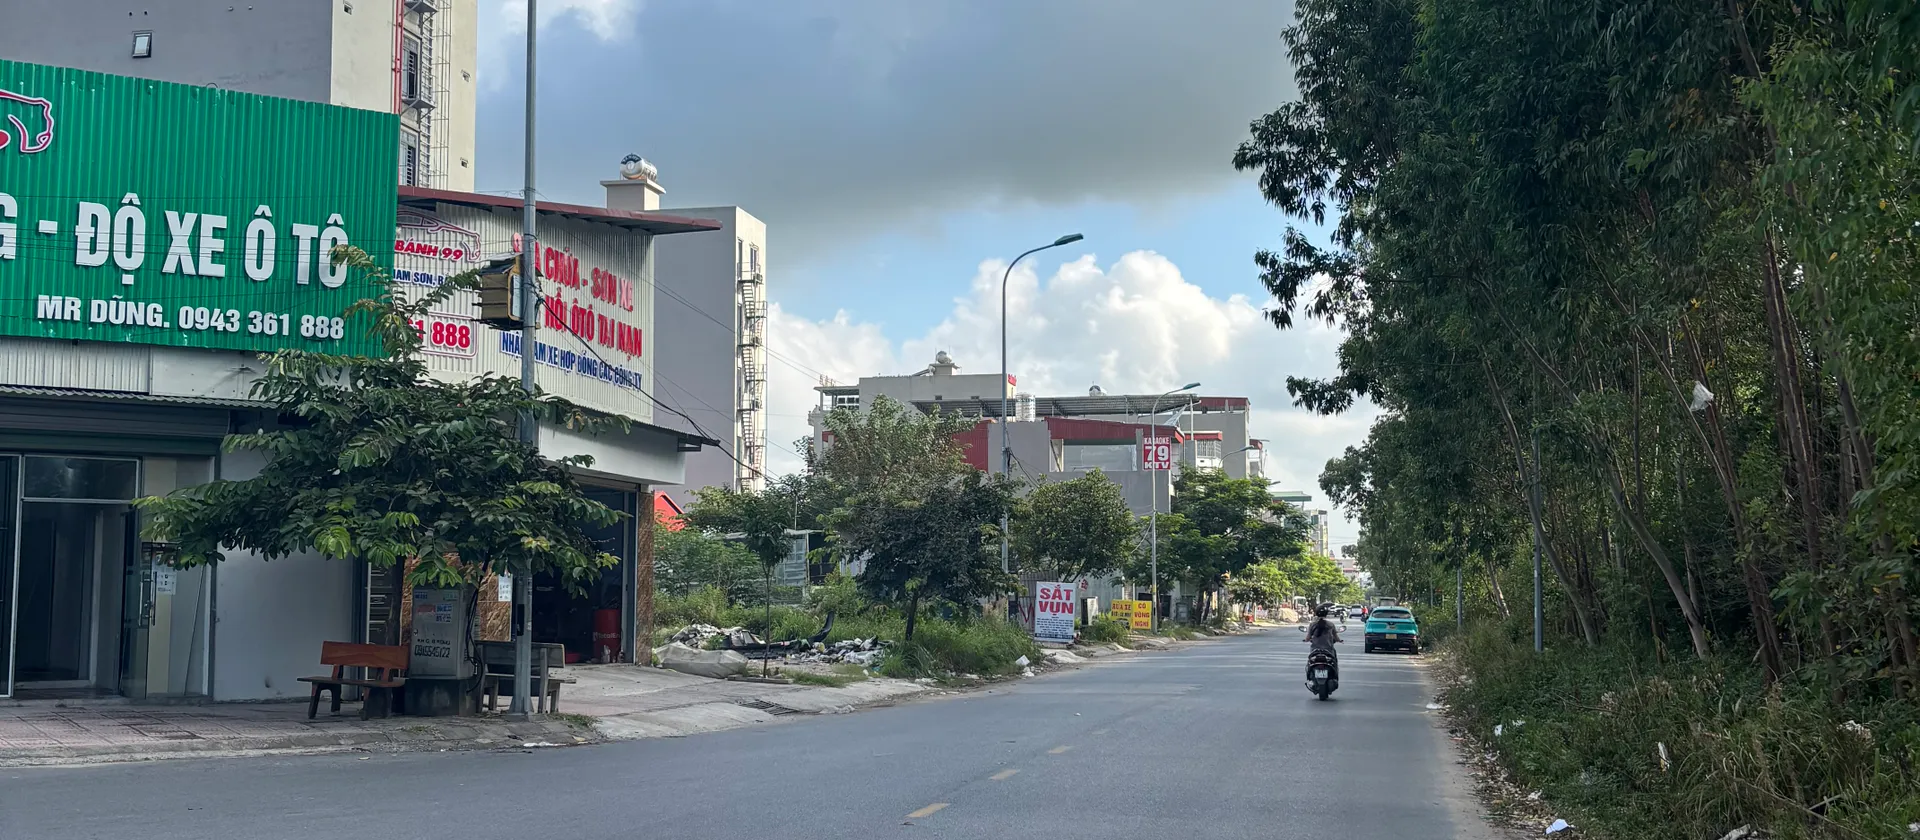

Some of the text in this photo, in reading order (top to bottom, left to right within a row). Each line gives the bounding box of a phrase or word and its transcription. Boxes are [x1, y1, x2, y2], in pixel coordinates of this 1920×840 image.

[75, 192, 146, 285] ĐỘ
[162, 210, 227, 277] XE
[244, 204, 276, 281] Ô
[292, 213, 349, 288] TÔ
[394, 238, 463, 260] BÁNH 99
[619, 277, 633, 312] XE
[37, 294, 344, 340] MR DŨNG. 0943 361 888
[432, 321, 471, 348] 888
[617, 321, 642, 361] NẠN
[548, 345, 558, 365] XE
[1144, 445, 1169, 461] 79
[1144, 461, 1170, 469] KTV
[1039, 584, 1073, 601] SẮT
[1038, 601, 1074, 616] VỤN
